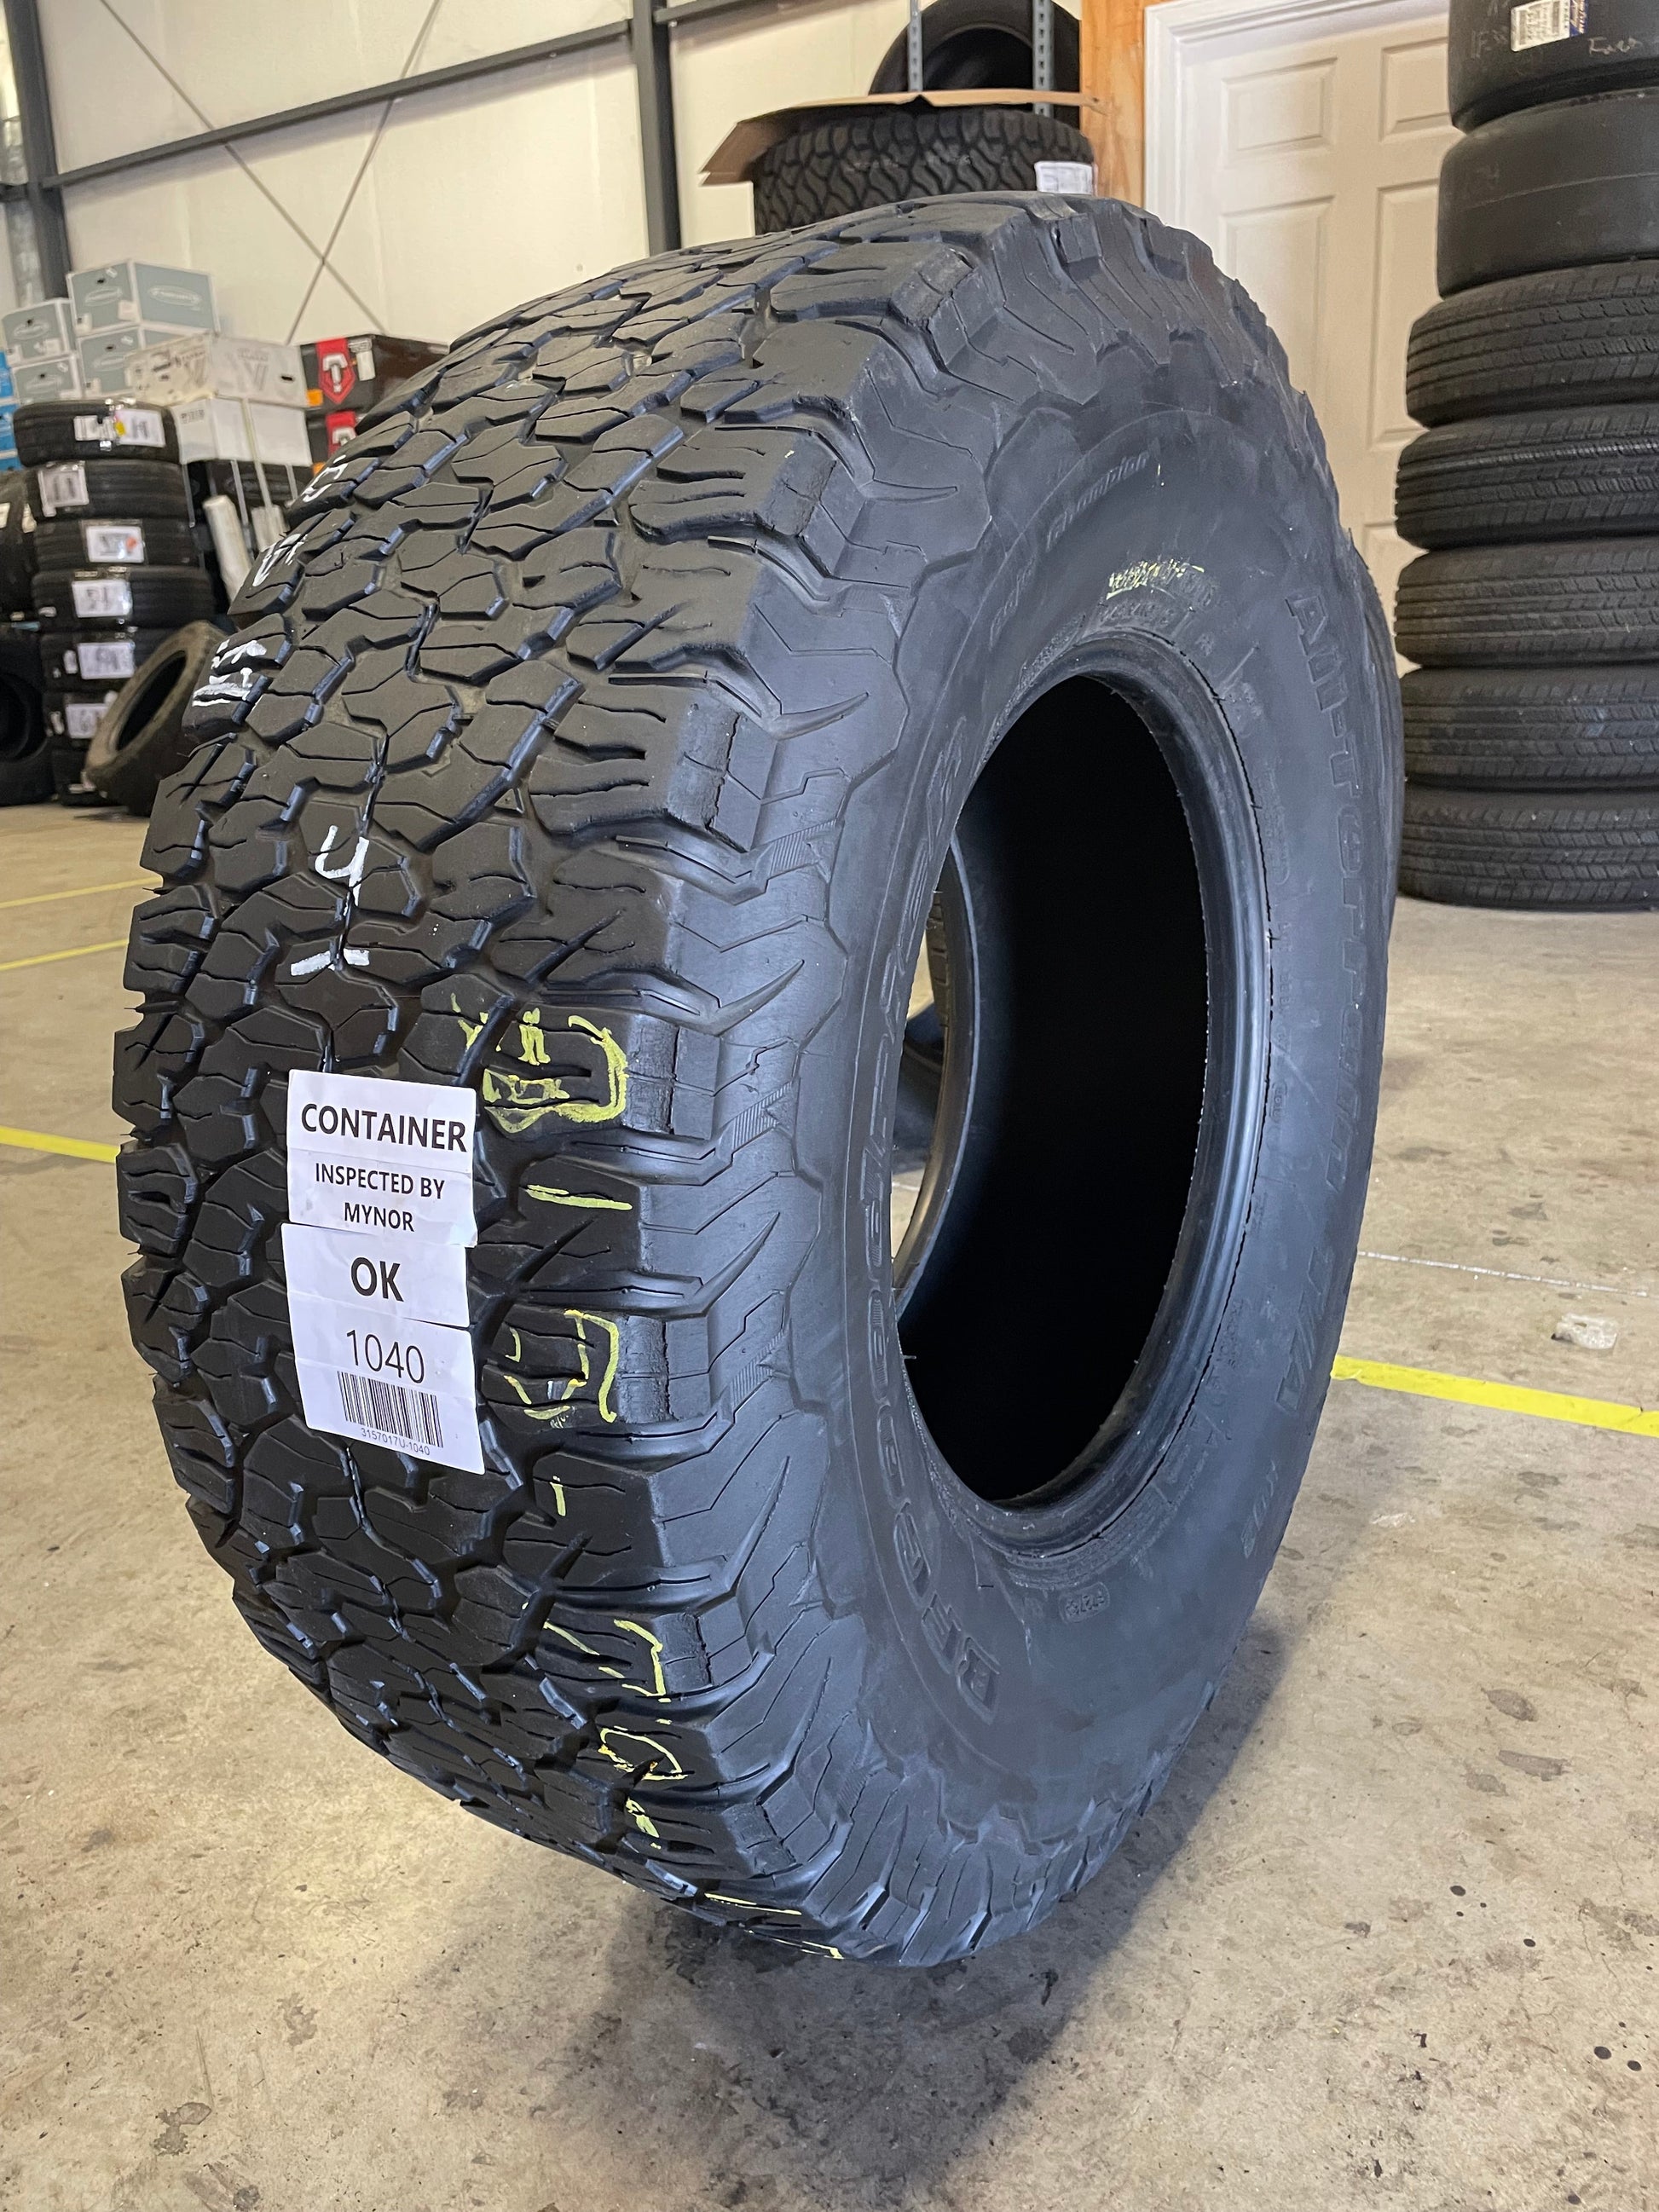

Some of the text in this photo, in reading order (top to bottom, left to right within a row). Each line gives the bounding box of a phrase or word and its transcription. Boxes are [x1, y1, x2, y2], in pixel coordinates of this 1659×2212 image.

[301, 1103, 467, 1152] CONTAINER
[315, 1163, 445, 1199] INSPECTED BY
[344, 1203, 415, 1232] MYNOR
[350, 1256, 404, 1302] OK
[346, 1330, 425, 1384] 1040
[361, 1427, 431, 1456] 3157017U-1040
